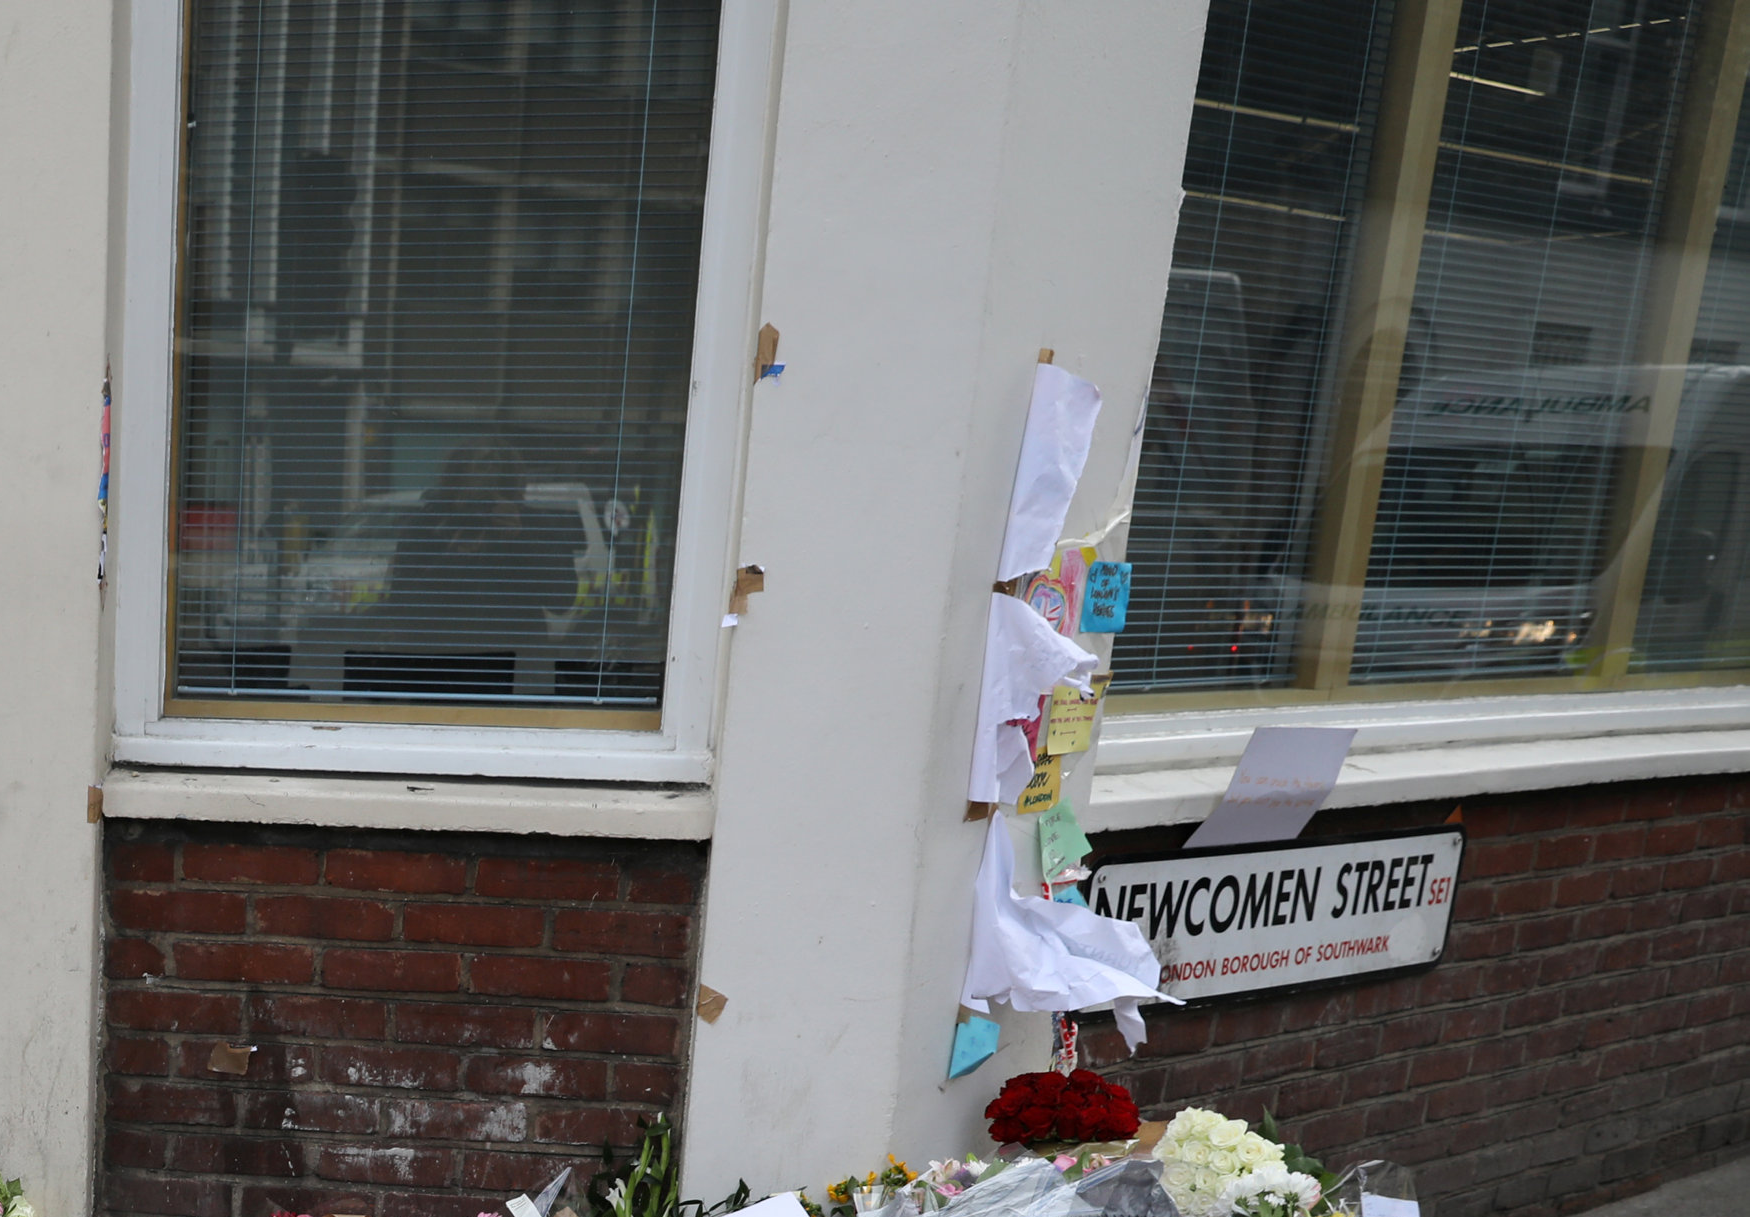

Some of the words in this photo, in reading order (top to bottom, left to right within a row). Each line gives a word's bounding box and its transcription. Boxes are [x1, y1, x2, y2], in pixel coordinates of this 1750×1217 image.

[1331, 854, 1435, 919] STREET
[1427, 877, 1452, 906] SE1
[1160, 958, 1216, 984] ONDON
[1220, 950, 1289, 977] BOROUGH
[1291, 948, 1312, 968] OF
[1316, 936, 1390, 962] SOUTHWARK
